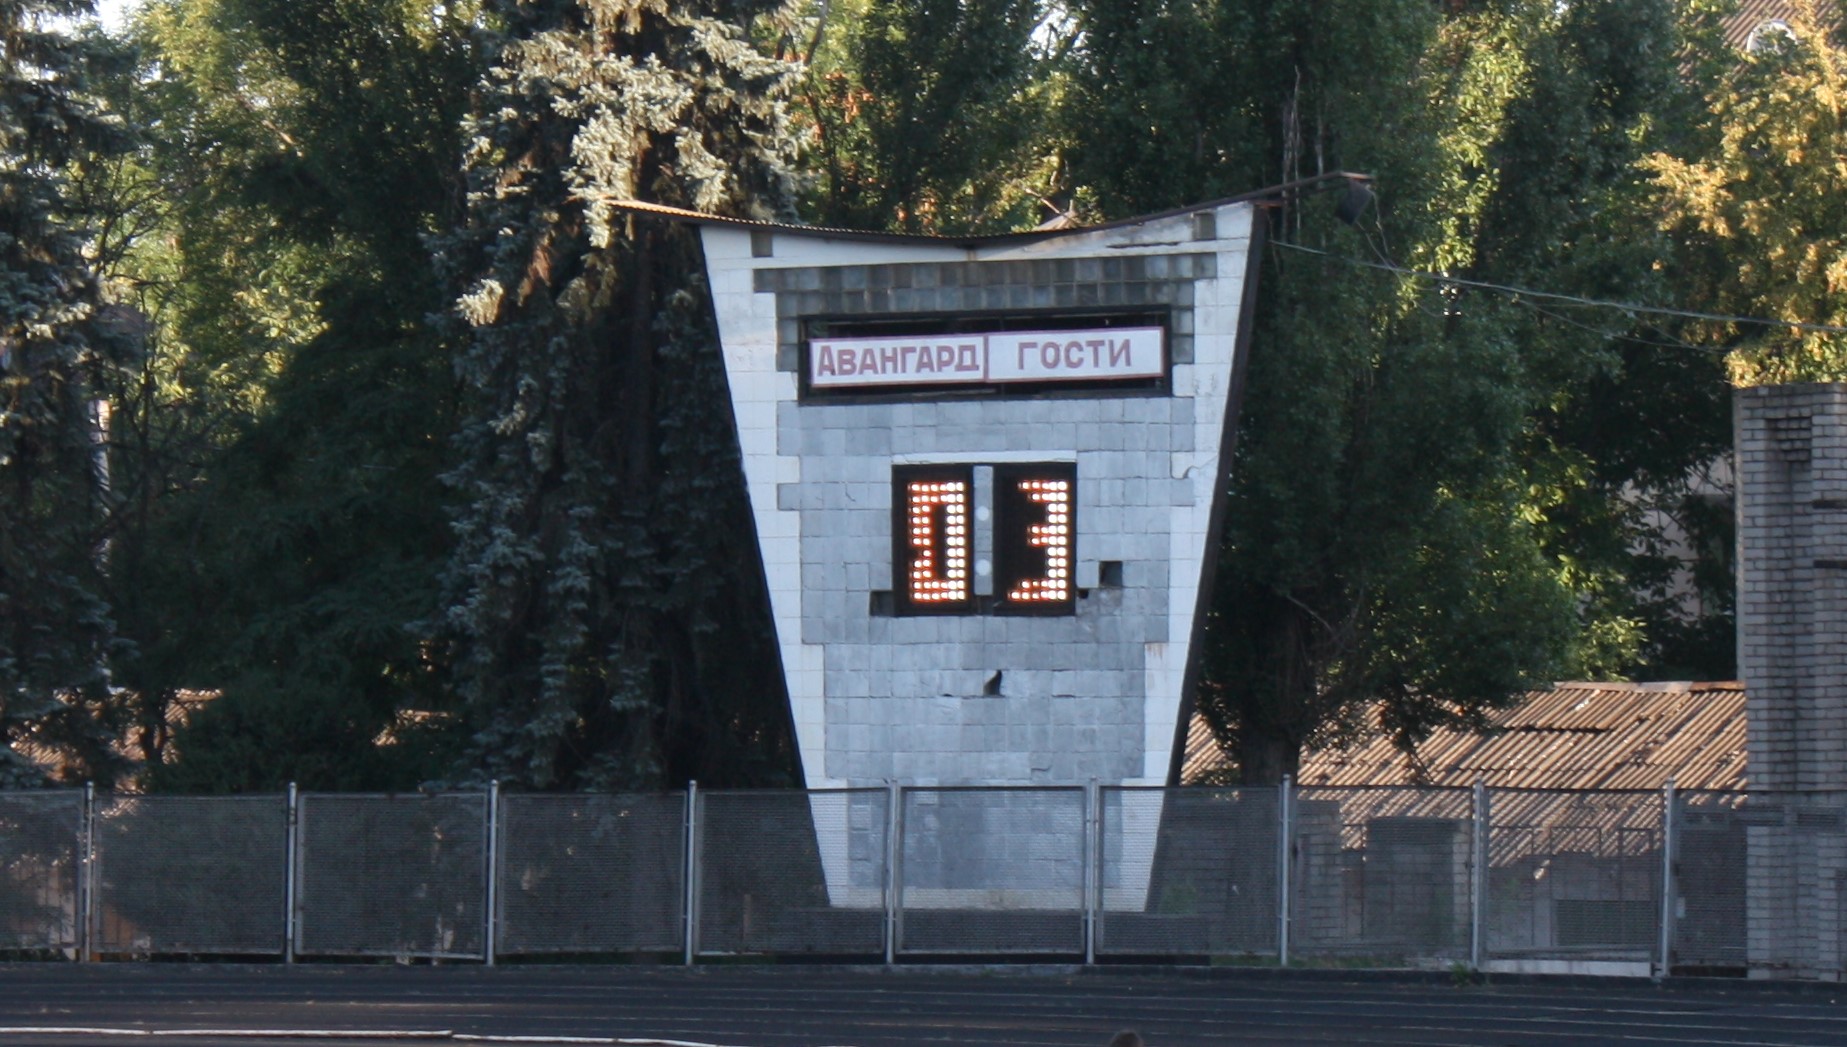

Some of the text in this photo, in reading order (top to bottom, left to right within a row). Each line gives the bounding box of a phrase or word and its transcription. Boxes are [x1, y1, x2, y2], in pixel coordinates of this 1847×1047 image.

[817, 344, 979, 376] АВАНГАРД
[1017, 339, 1131, 370] ГОСТИ
[908, 481, 966, 601] 0
[1007, 480, 1069, 601] 3
